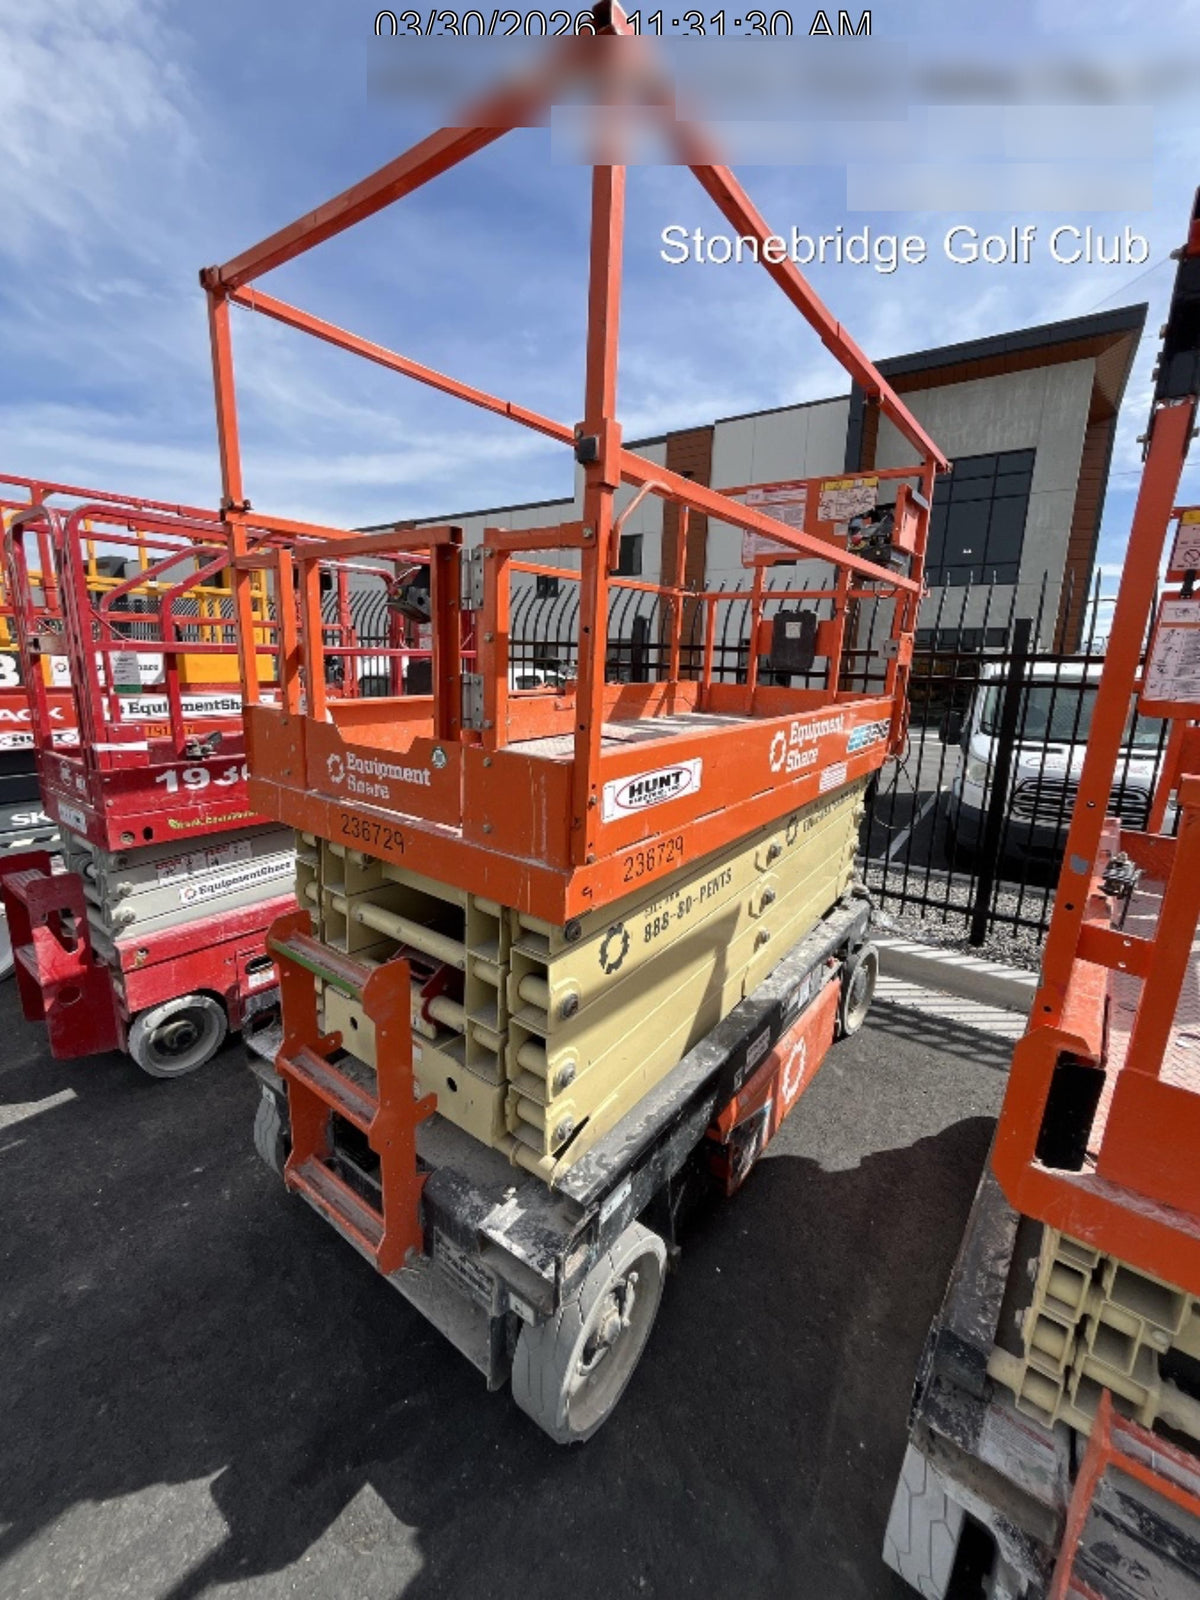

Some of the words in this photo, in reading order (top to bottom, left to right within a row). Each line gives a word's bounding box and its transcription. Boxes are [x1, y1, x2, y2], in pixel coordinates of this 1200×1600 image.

[789, 712, 845, 747] Equipment
[345, 751, 432, 787] Equipment
[785, 747, 819, 774] Share
[628, 770, 684, 799] HUNT
[340, 813, 405, 855] 236729
[623, 834, 684, 883] 236729
